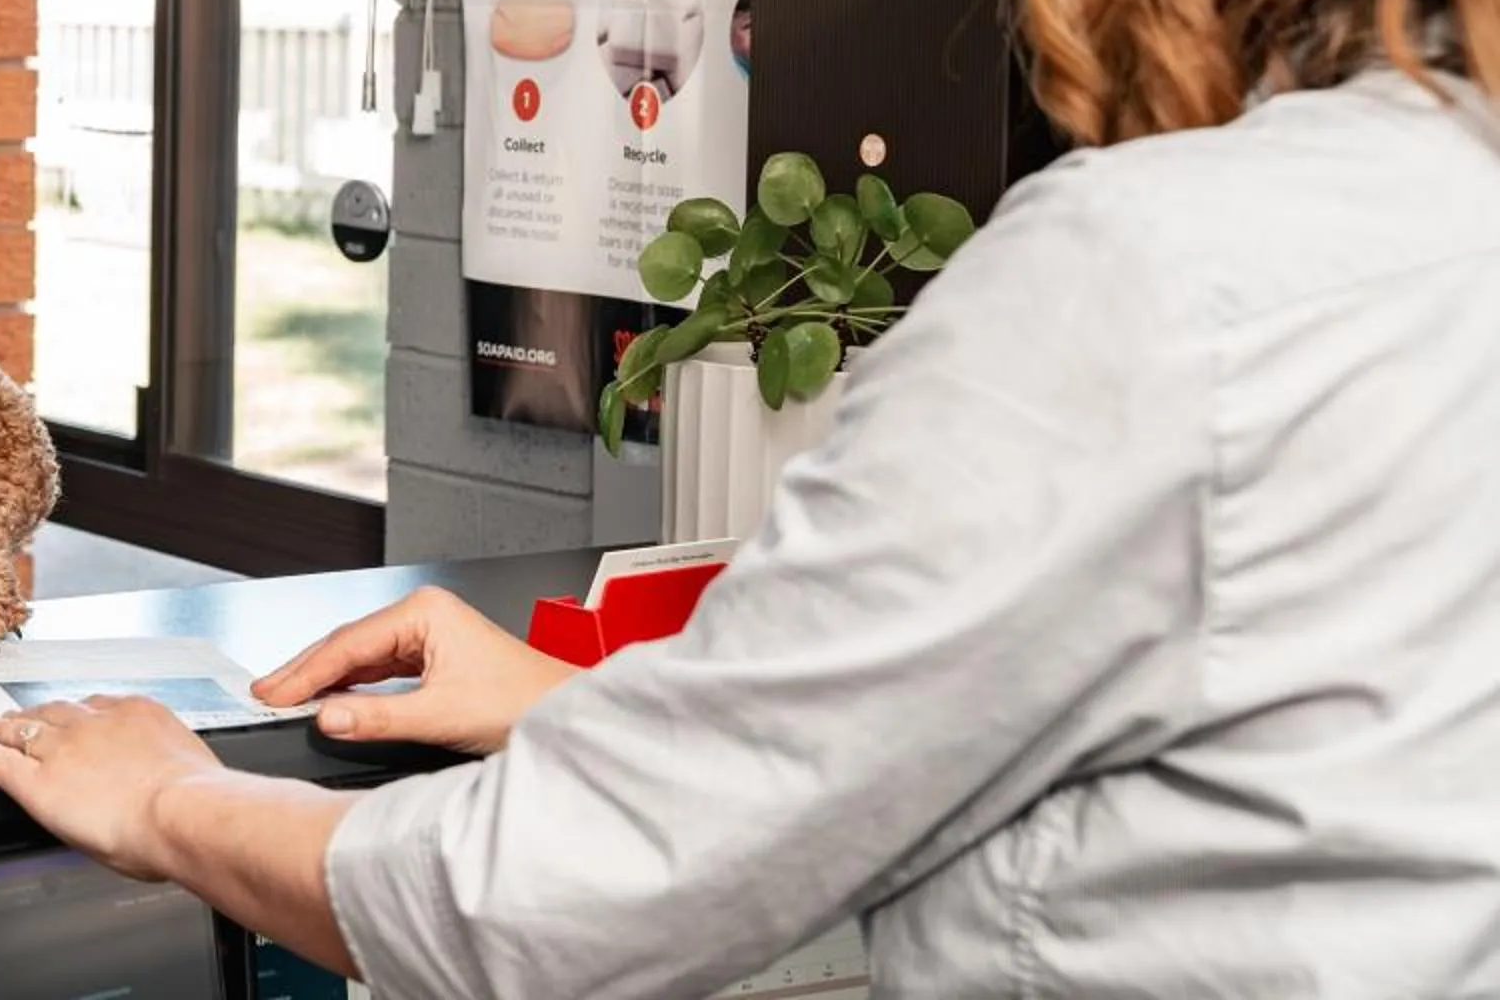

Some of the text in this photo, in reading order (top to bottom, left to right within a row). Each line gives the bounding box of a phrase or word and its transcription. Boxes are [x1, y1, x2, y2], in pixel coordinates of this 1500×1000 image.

[638, 97, 650, 116] 2
[504, 137, 545, 154] Collect
[623, 145, 667, 165] Recycle
[477, 340, 556, 366] SOAPAID.ORG
